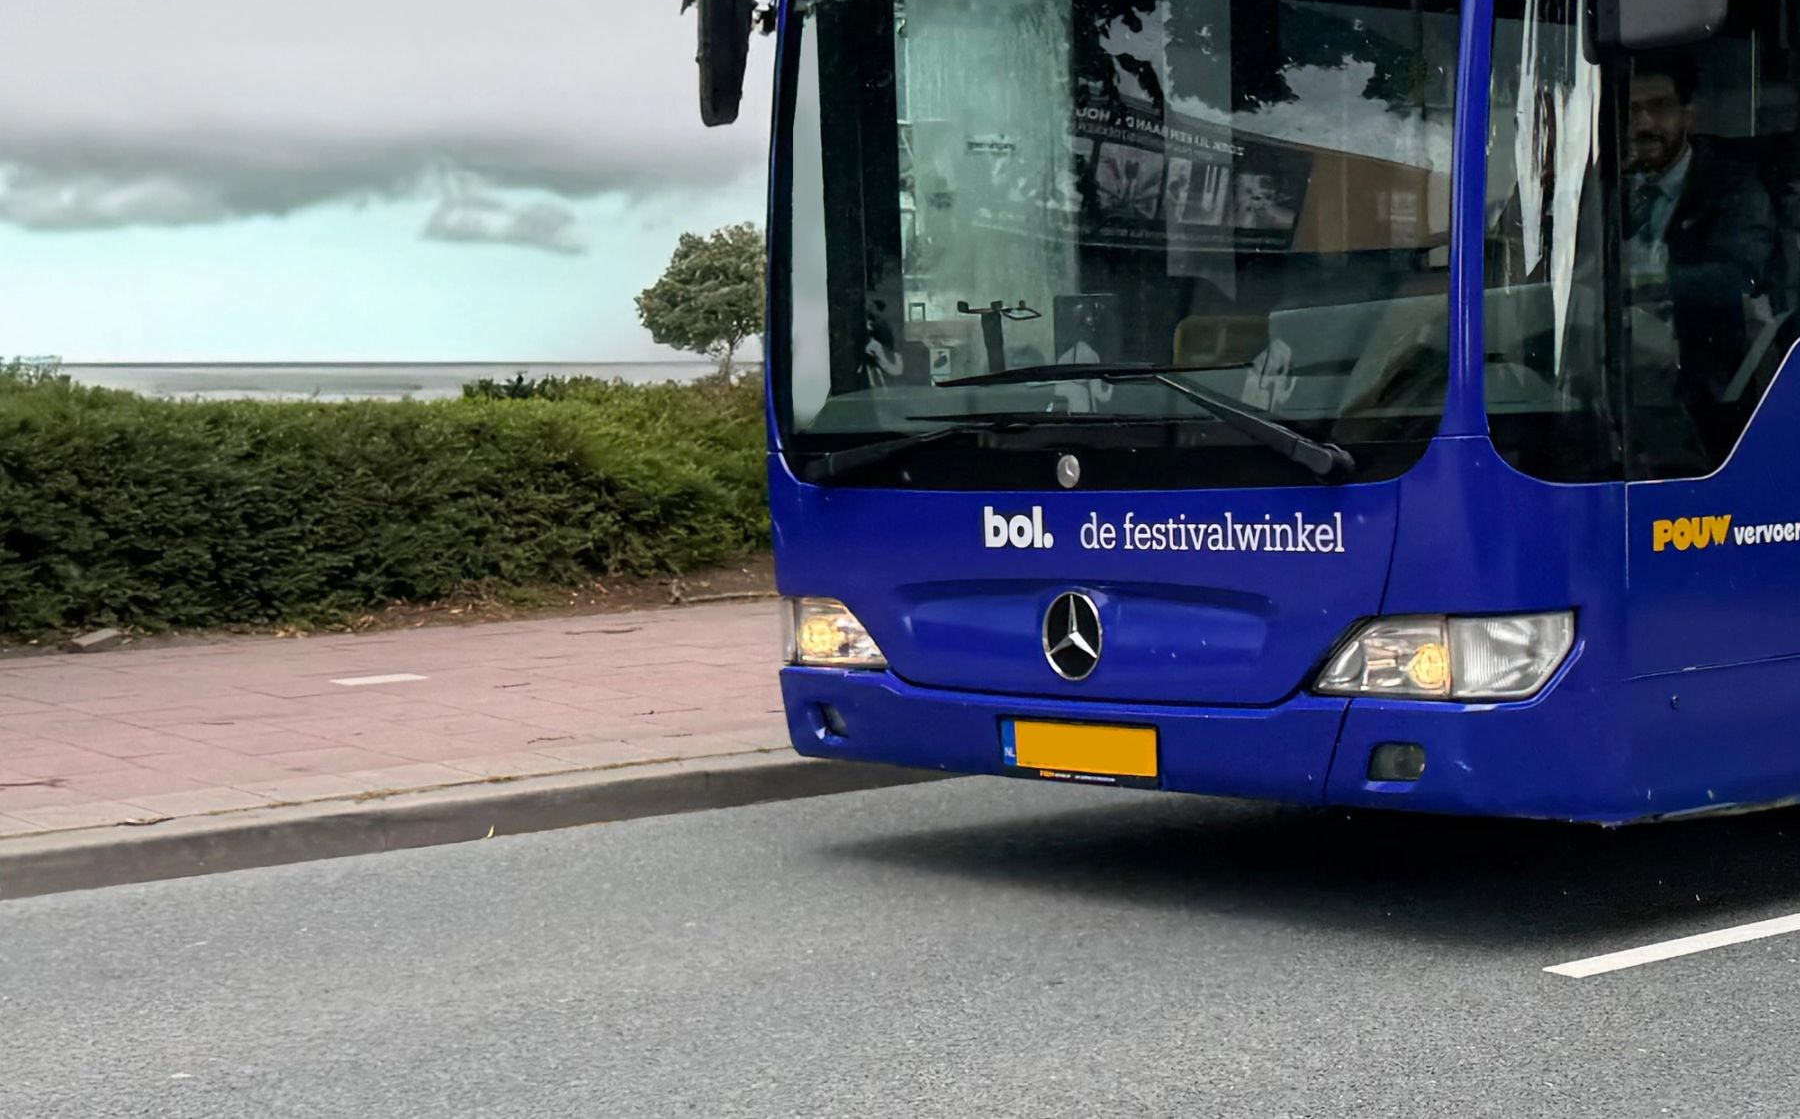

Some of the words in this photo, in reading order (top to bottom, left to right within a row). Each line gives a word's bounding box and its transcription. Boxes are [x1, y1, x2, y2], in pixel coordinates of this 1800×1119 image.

[983, 505, 1055, 549] bol.
[1080, 512, 1116, 549] de
[1124, 511, 1346, 553] festivalwinkel
[1652, 514, 1732, 552] POUW
